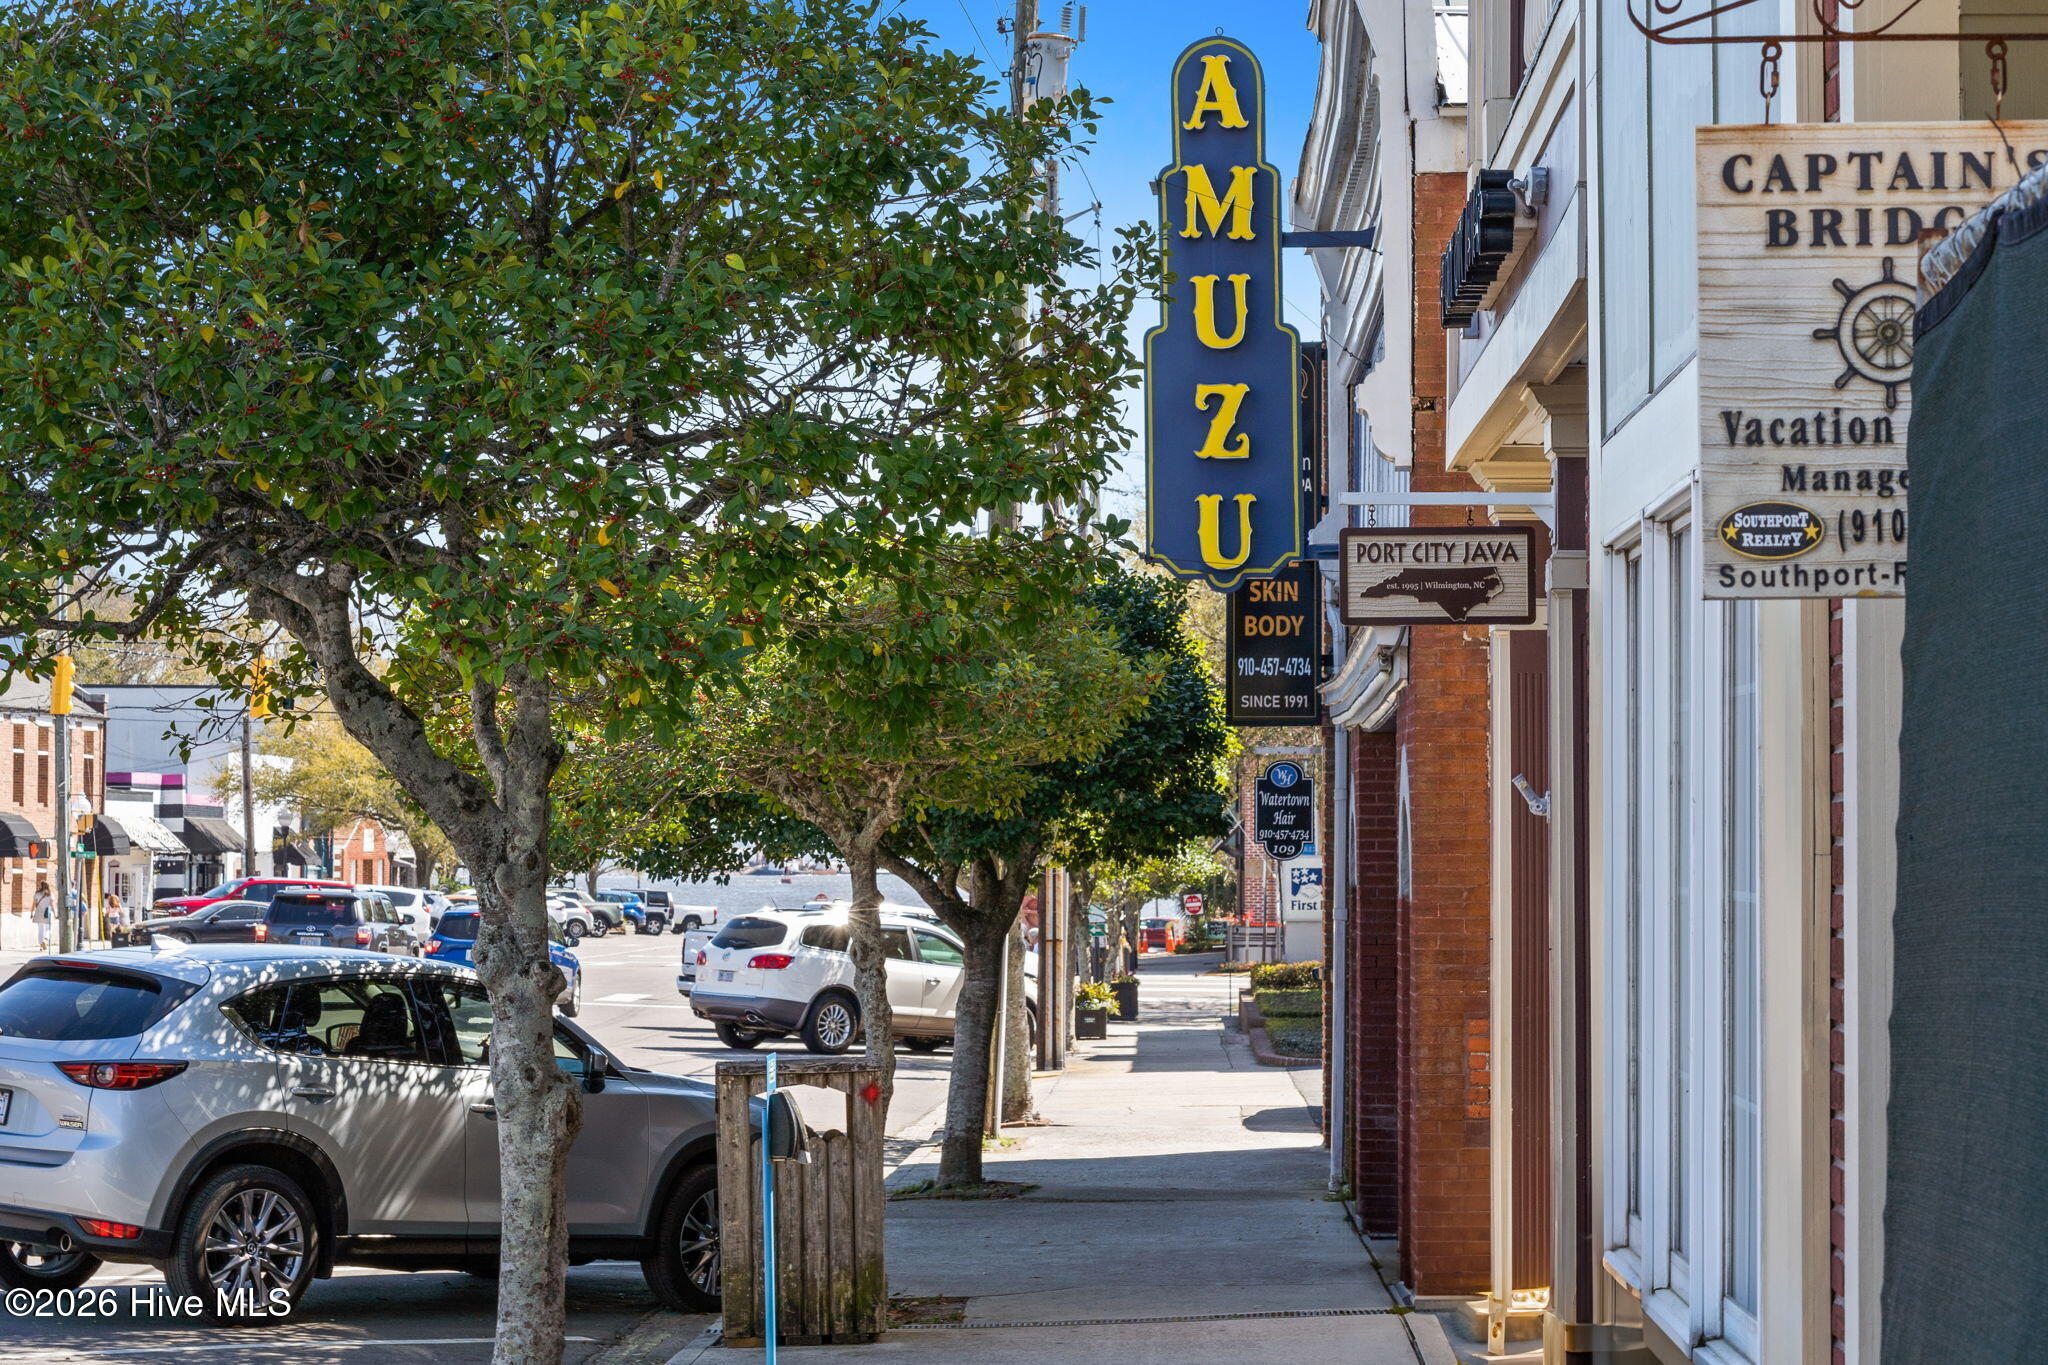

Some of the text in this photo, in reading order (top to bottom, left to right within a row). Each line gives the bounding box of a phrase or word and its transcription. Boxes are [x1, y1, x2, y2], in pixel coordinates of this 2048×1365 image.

[1765, 206, 1986, 248] BRIDG
[1178, 53, 1259, 570] AMUZU
[1719, 408, 1895, 447] Vacation
[1734, 511, 1809, 529] SOUTHPORT
[1742, 532, 1803, 547] REALTY
[1356, 541, 1519, 564] PORT CITY JAVA
[1249, 580, 1299, 603] SKIN
[1386, 582, 1400, 590] est.
[1401, 583, 1419, 591] 1995
[1424, 581, 1472, 591] Wilmington,
[1244, 615, 1305, 637] BODY
[1237, 657, 1311, 677] 910-457-4734
[1241, 695, 1308, 708] SINCE 1991
[1258, 790, 1310, 806] Watertown
[1272, 811, 1296, 826] Hair
[1272, 844, 1295, 855] 109
[1291, 900, 1318, 911] First
